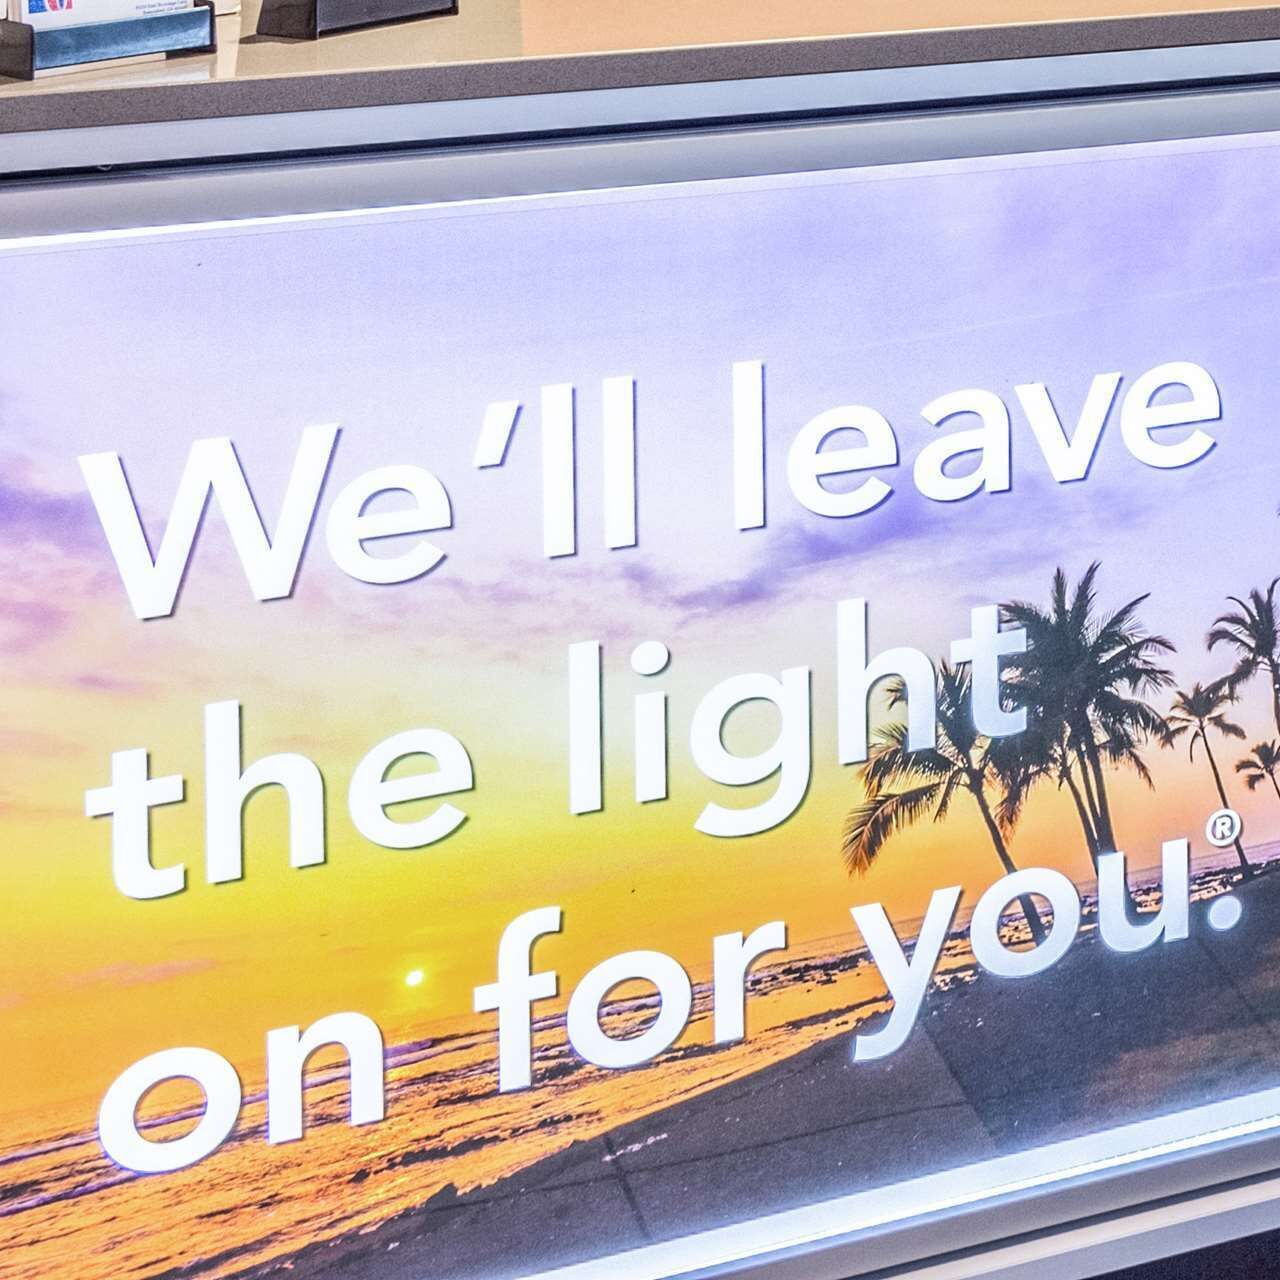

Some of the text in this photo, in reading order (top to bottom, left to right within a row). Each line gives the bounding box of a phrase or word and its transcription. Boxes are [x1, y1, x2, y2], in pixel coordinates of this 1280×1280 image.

[731, 358, 1226, 532] leave
[83, 596, 1031, 902] the light
[95, 1008, 389, 1178] on
[472, 906, 789, 1095] for
